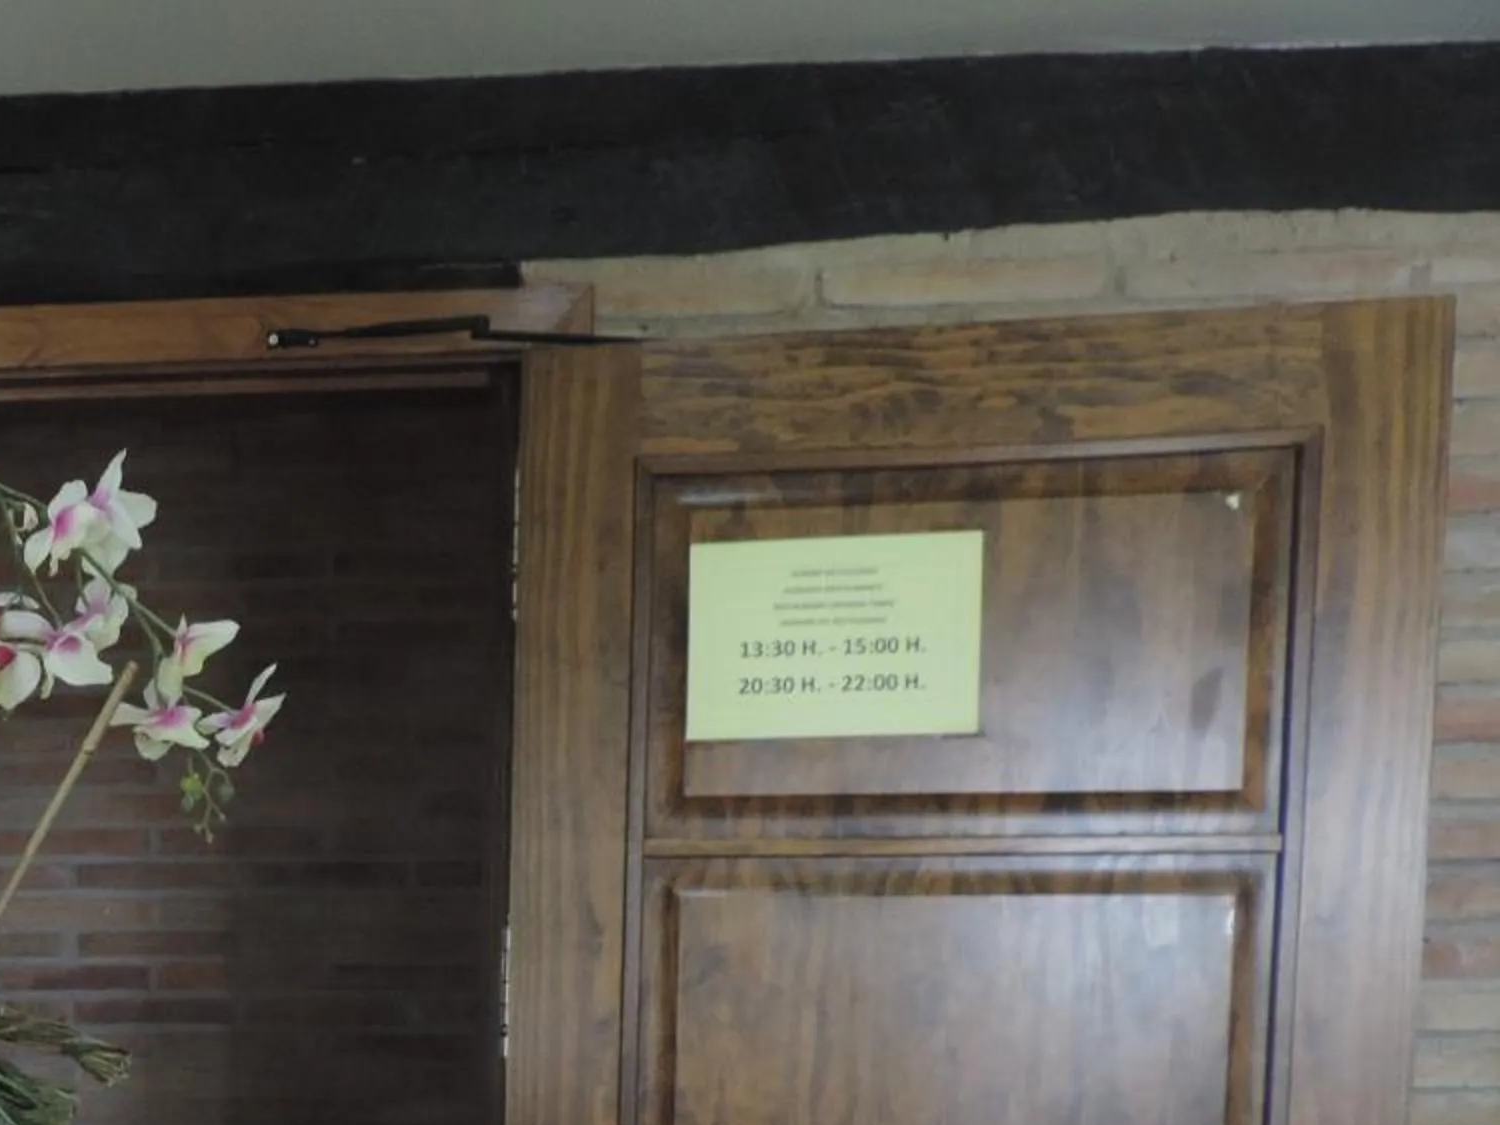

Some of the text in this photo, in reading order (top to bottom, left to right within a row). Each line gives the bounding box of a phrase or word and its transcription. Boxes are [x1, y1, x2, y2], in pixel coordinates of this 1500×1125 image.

[739, 640, 796, 659] 13:30
[843, 637, 899, 656] 15:00
[738, 677, 795, 695] 20:30
[841, 673, 899, 692] 22:00
